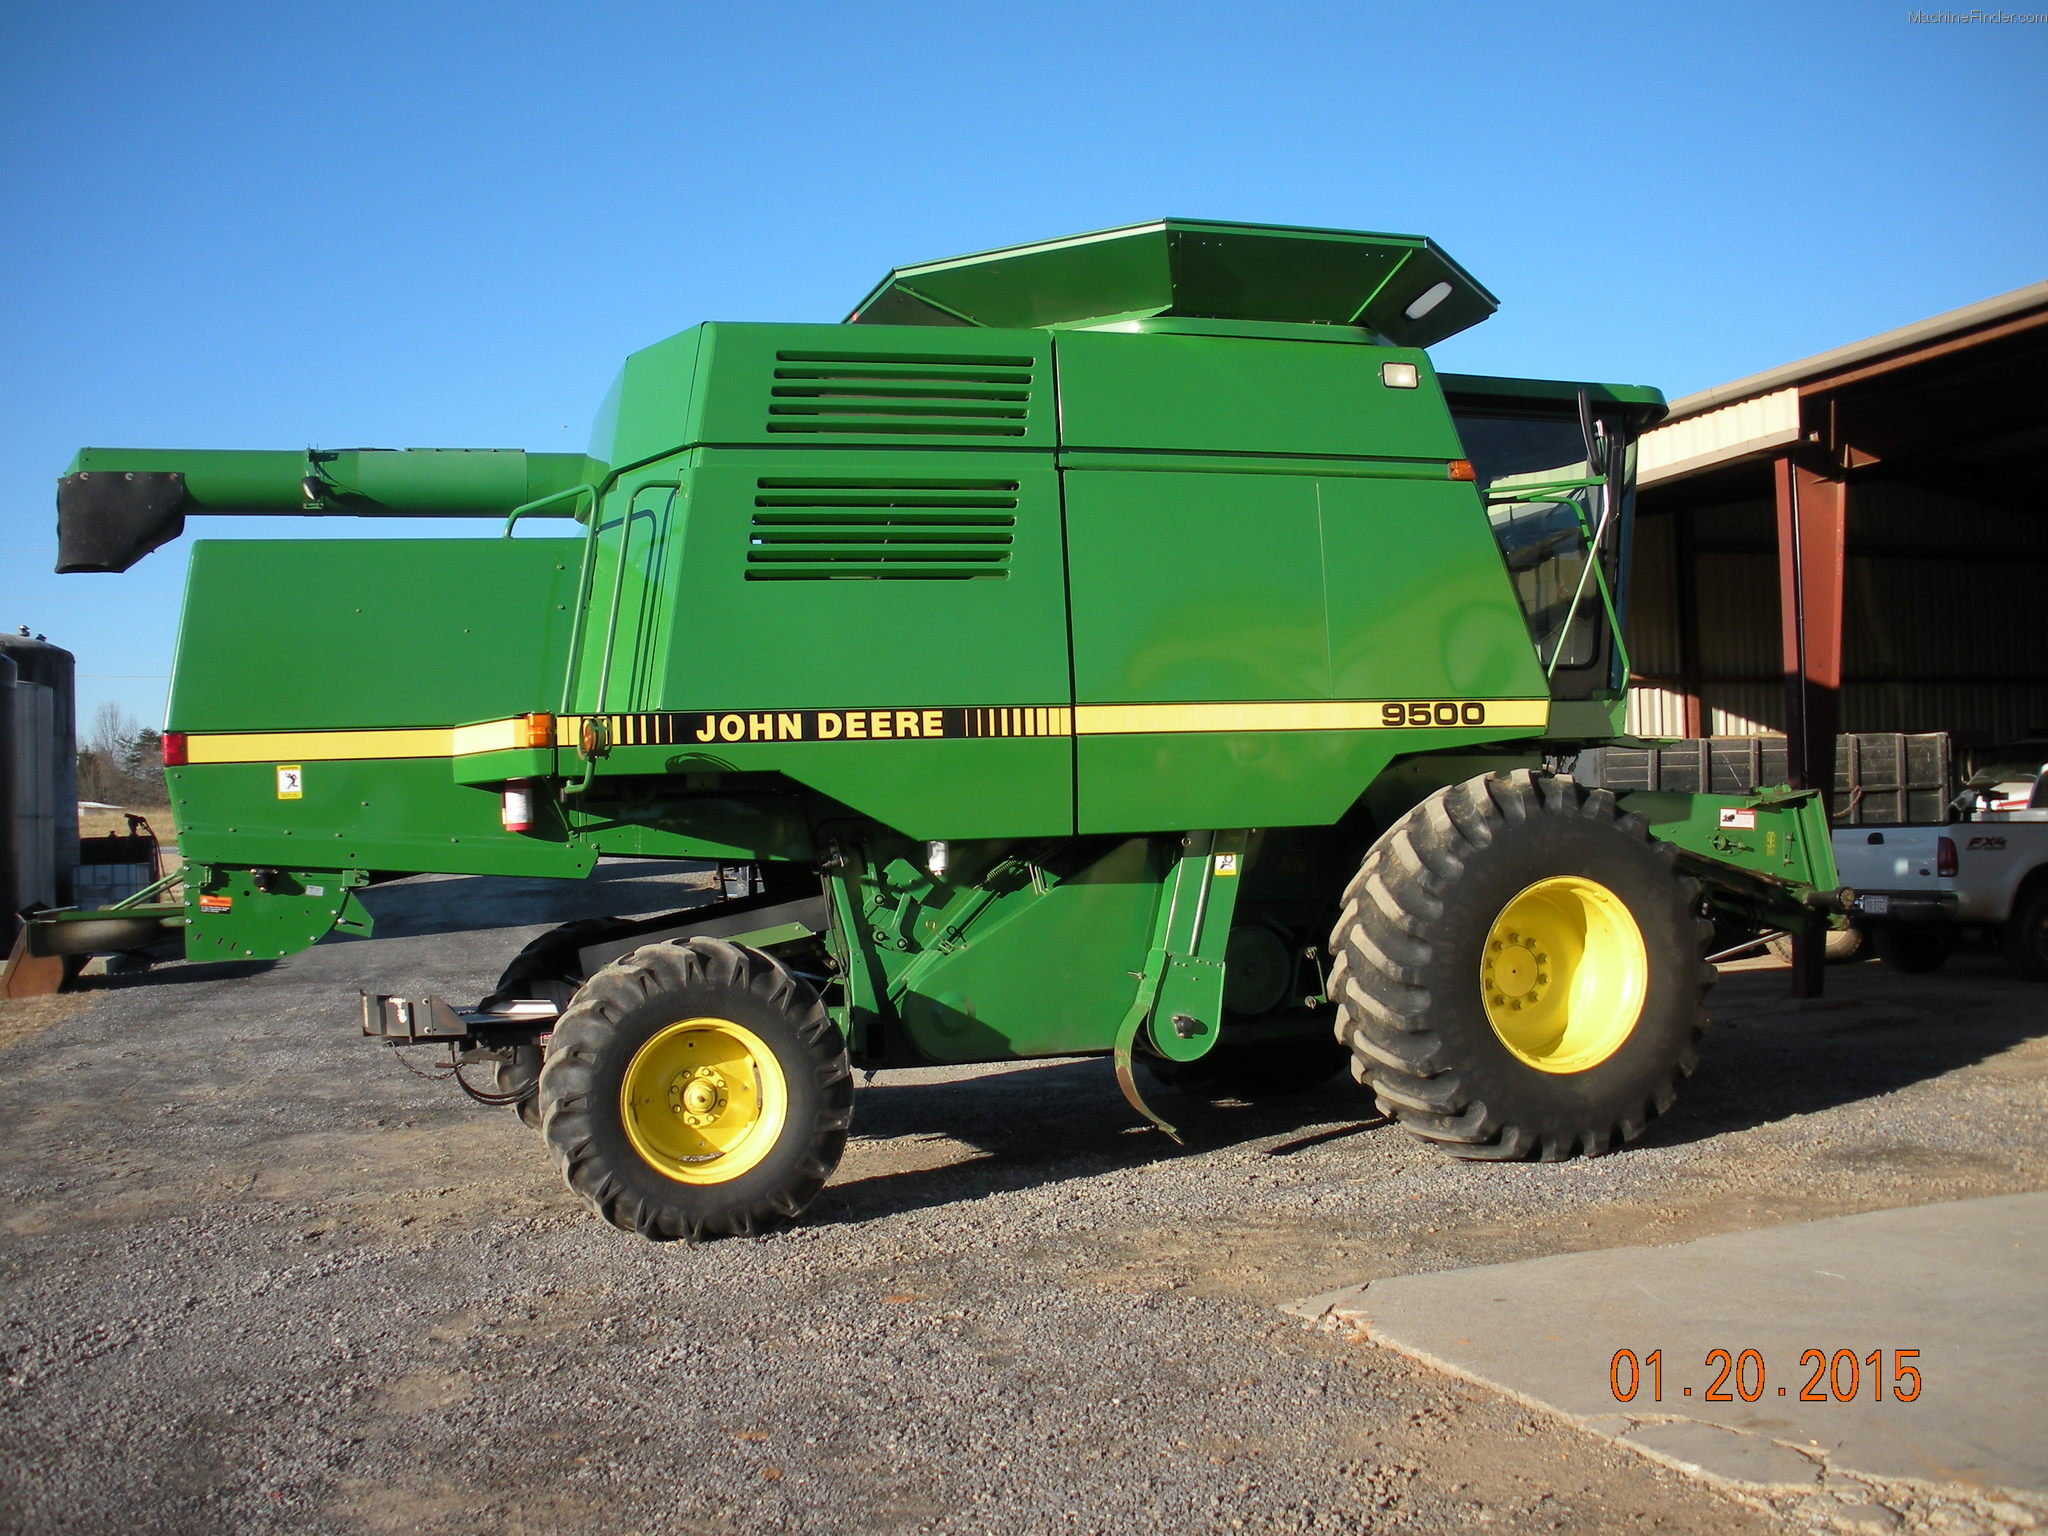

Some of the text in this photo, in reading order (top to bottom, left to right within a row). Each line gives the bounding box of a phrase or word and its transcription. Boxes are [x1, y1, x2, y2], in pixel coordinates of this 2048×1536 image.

[1381, 702, 1485, 726] 9500
[696, 710, 944, 743] JOHN DEERE
[1967, 836, 2007, 848] FX4
